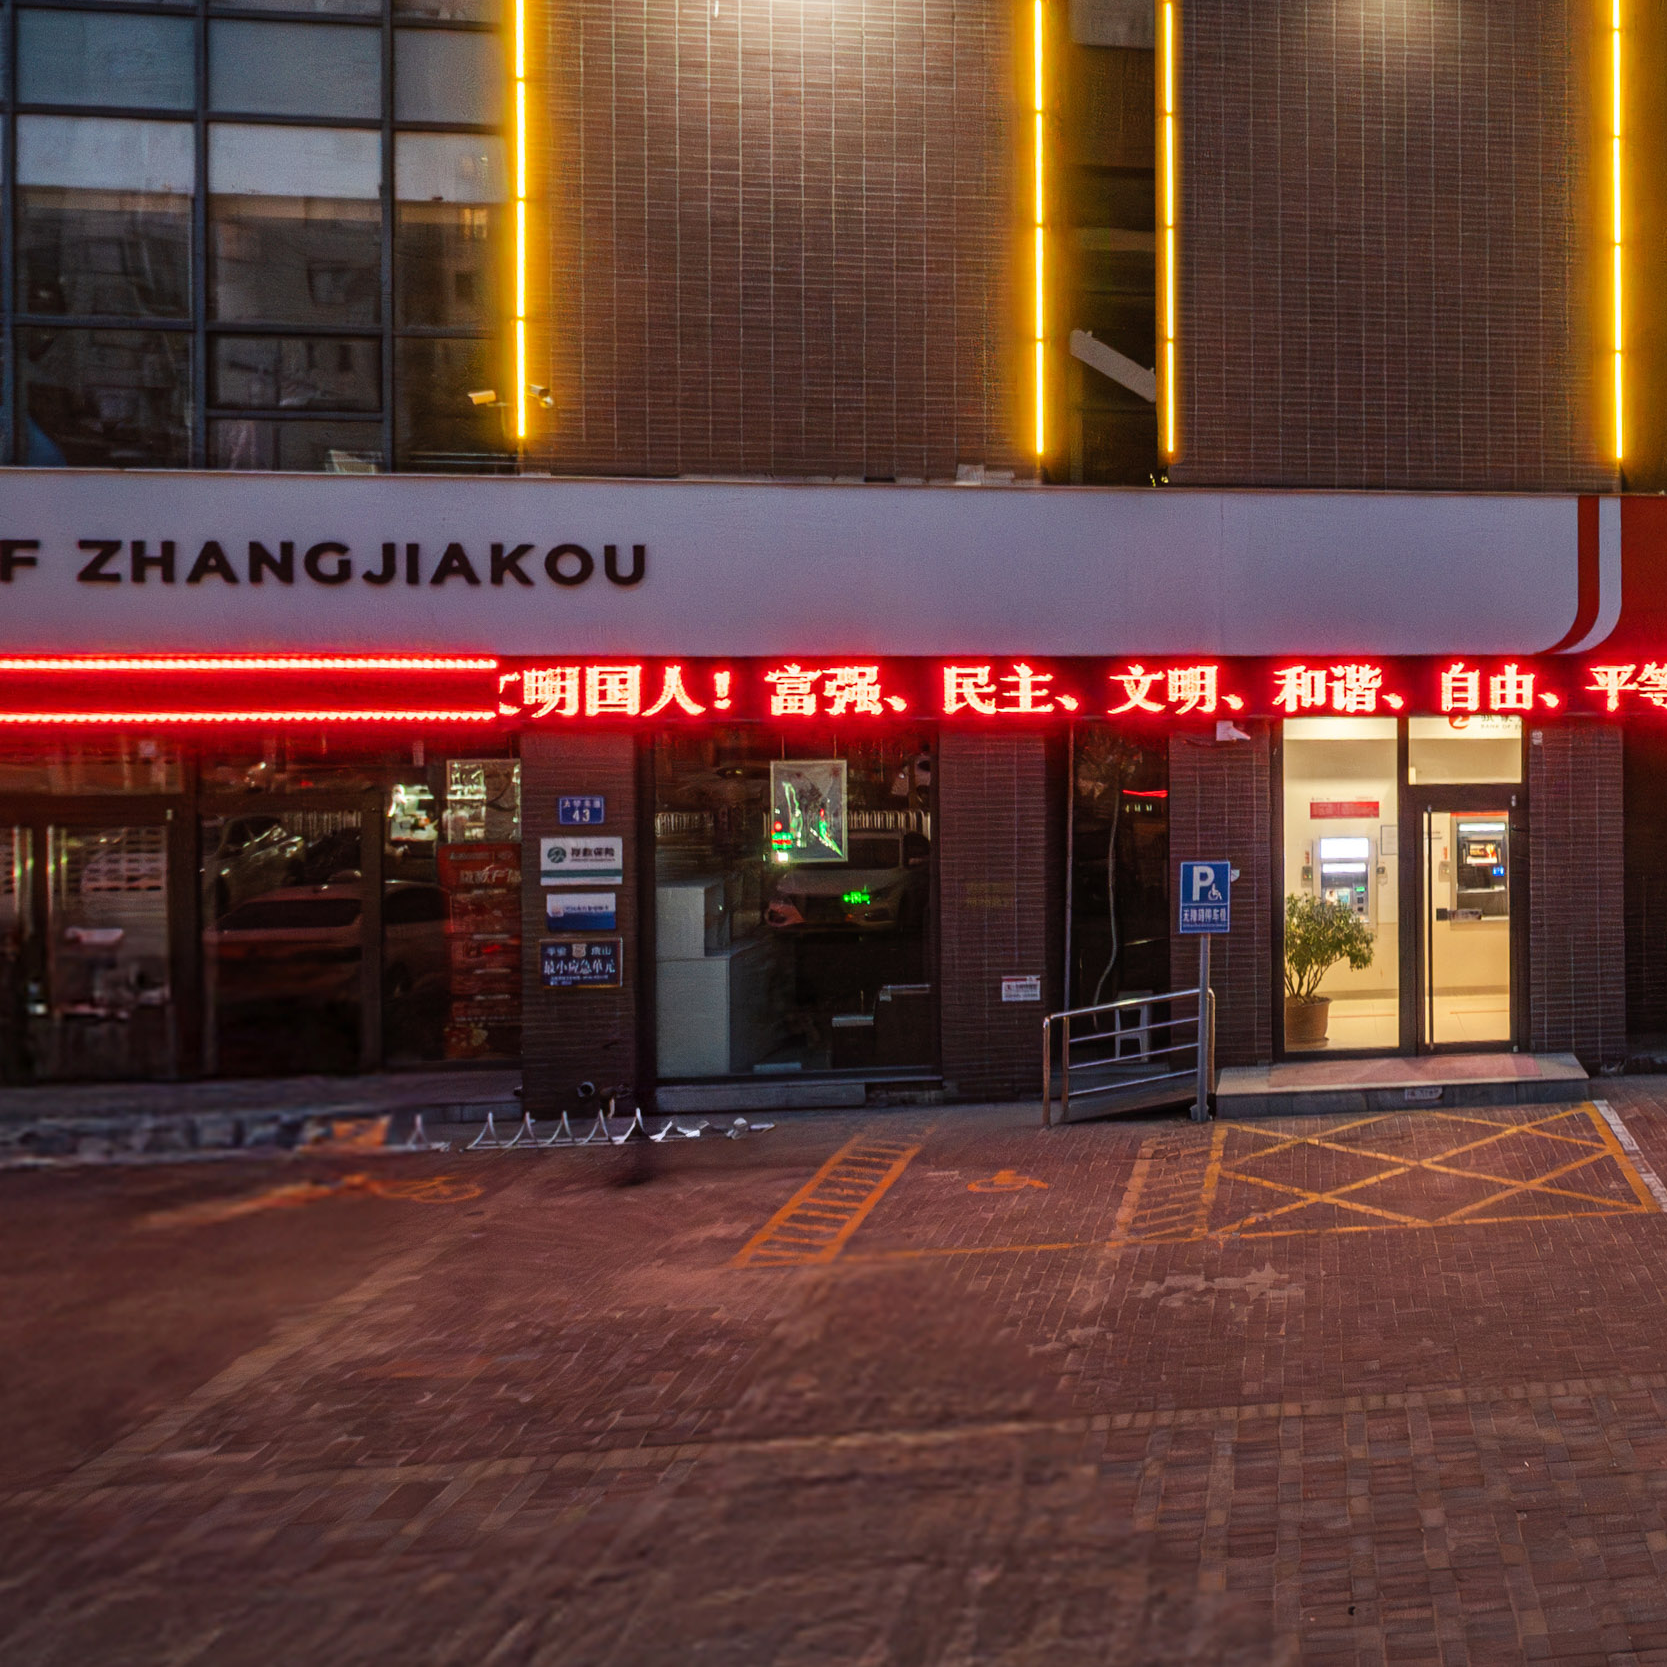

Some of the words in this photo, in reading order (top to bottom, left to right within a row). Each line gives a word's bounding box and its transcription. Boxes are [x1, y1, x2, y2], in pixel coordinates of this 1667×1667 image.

[78, 539, 647, 586] ZHANGJIAKOU
[572, 808, 591, 823] 43
[1192, 865, 1215, 902] P
